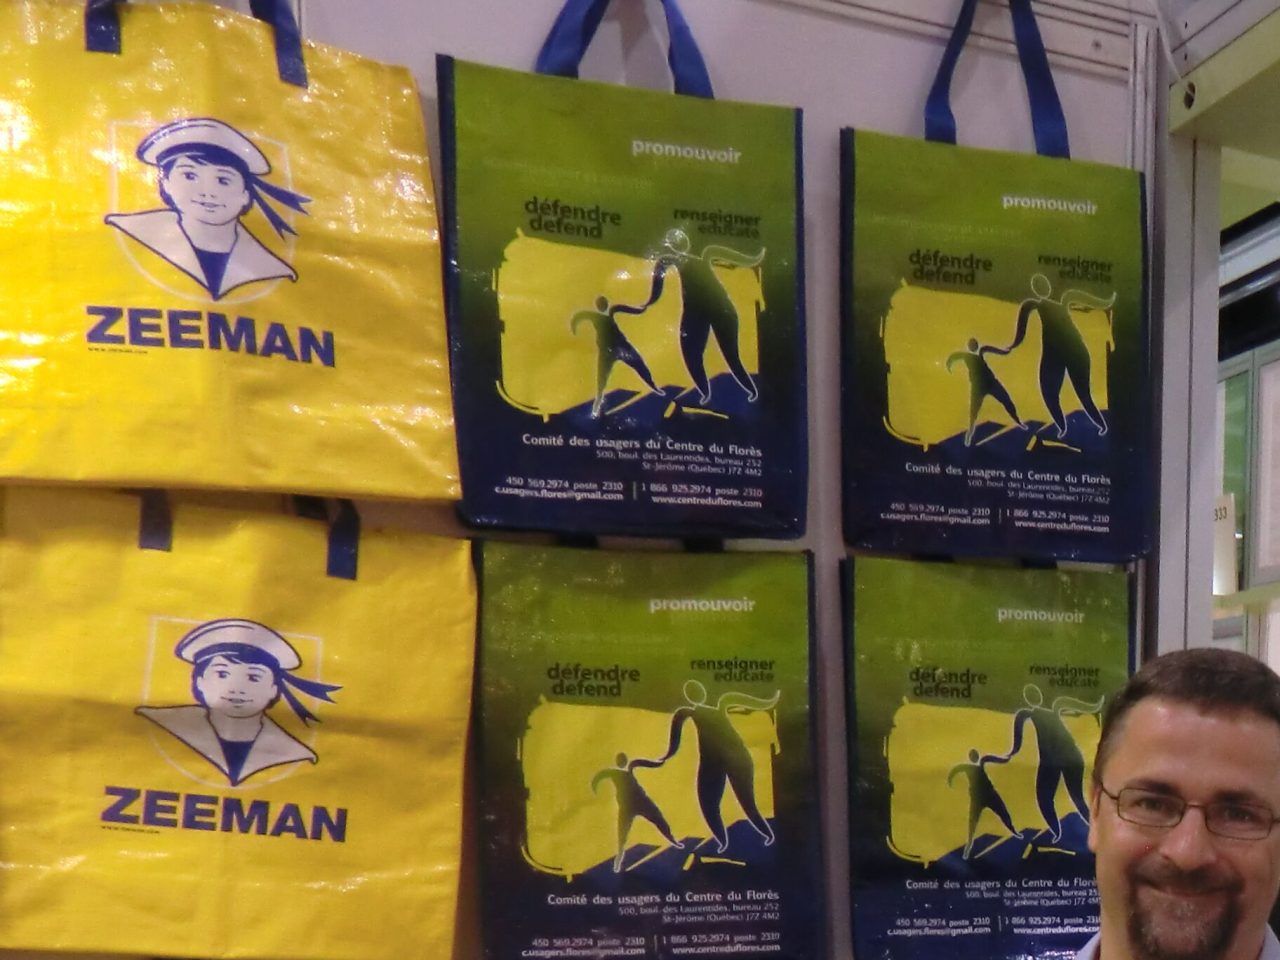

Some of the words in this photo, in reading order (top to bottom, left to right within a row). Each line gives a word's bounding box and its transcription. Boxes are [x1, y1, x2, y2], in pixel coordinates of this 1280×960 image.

[632, 139, 742, 164] promouvoir
[524, 196, 622, 226] défendre
[1002, 195, 1098, 216] promouvoir
[673, 207, 761, 226] renseigner
[529, 216, 603, 239] defend
[909, 247, 993, 272] défendre
[1038, 254, 1114, 272] renseigner
[913, 264, 975, 286] defend
[86, 305, 335, 368] ZEEMAN
[522, 434, 564, 447] Comité
[569, 436, 591, 447] des
[595, 439, 640, 451] usagers
[645, 439, 661, 450] du
[666, 439, 703, 452] Centre
[709, 442, 724, 453] du
[729, 444, 762, 457] Florès
[905, 462, 941, 474] Comité
[946, 464, 963, 475] des
[967, 469, 1006, 479] usagers
[1010, 470, 1023, 479] du
[1027, 471, 1060, 482] Centre
[1065, 474, 1077, 483] du
[1081, 474, 1111, 485] Florès
[650, 597, 755, 614] promouvoir
[998, 607, 1085, 624] promouvoir
[547, 661, 641, 682] défendre
[690, 656, 775, 672] renseigner
[1029, 663, 1100, 678] renseigner
[552, 680, 622, 697] defend
[913, 683, 972, 699] defend
[101, 786, 348, 842] ZEEMAN
[906, 879, 939, 889] Comité
[943, 879, 960, 888] des
[964, 880, 1001, 890] usagers
[1004, 879, 1017, 888] du
[1021, 879, 1053, 888] Centre
[1056, 878, 1070, 887] du
[547, 894, 588, 905] Comité
[592, 894, 613, 905] des
[617, 895, 661, 906] usagers
[665, 892, 681, 902] du
[685, 891, 722, 902] Centre
[727, 890, 742, 901] du
[746, 890, 780, 900] Florès
